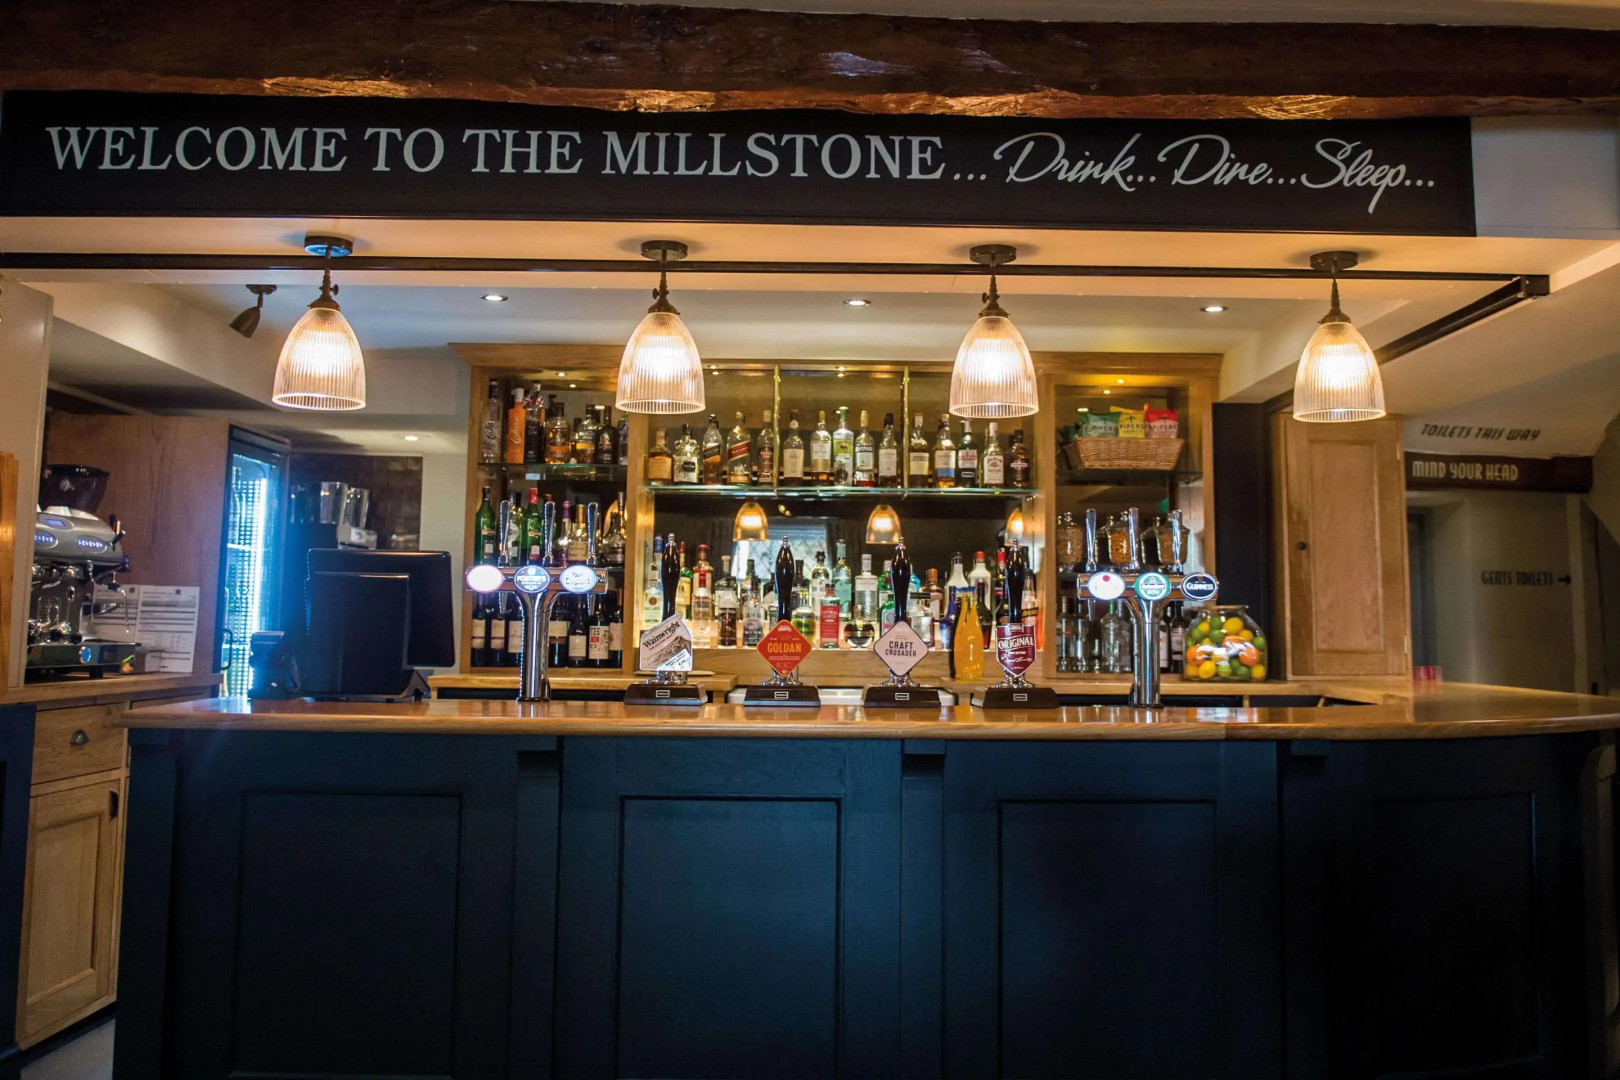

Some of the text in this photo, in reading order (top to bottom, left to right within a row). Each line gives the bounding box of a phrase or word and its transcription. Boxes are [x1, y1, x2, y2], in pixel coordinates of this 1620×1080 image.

[46, 126, 348, 171] WELCOME
[364, 127, 445, 172] TO
[463, 128, 583, 174] THE
[1421, 424, 1541, 441] TOILETS THIS WAY
[1412, 460, 1519, 482] MIND YOUR HEAD
[1481, 570, 1553, 586] GENTS TOILETS
[1186, 582, 1214, 591] GUINNESS
[643, 621, 681, 649] Wainwright
[767, 642, 802, 654] GOLDAN
[889, 641, 914, 650] CRAFT
[998, 636, 1034, 650] ORIGINAL
[885, 648, 917, 657] CRUSADER
